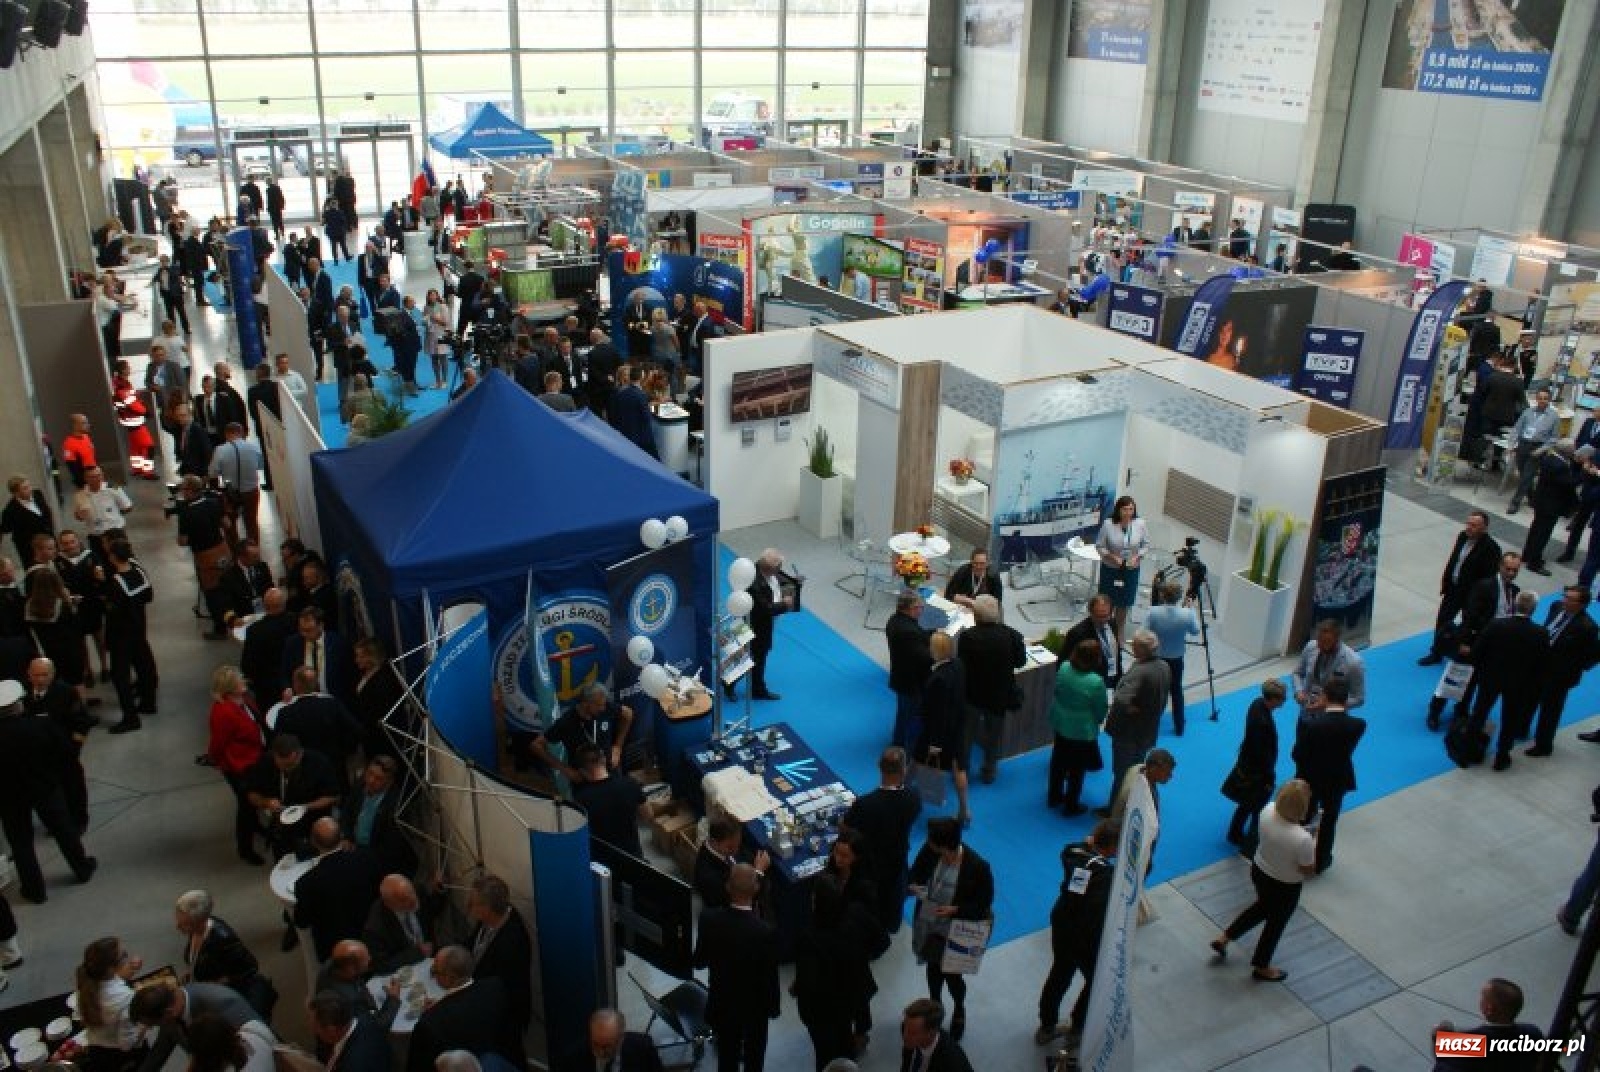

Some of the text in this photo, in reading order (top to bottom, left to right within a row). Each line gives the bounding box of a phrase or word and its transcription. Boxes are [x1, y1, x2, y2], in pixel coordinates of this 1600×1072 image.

[1448, 54, 1469, 69] mld
[1482, 62, 1491, 71] do
[1446, 75, 1467, 89] mld
[1479, 82, 1489, 91] do
[808, 215, 867, 231] Gogolin
